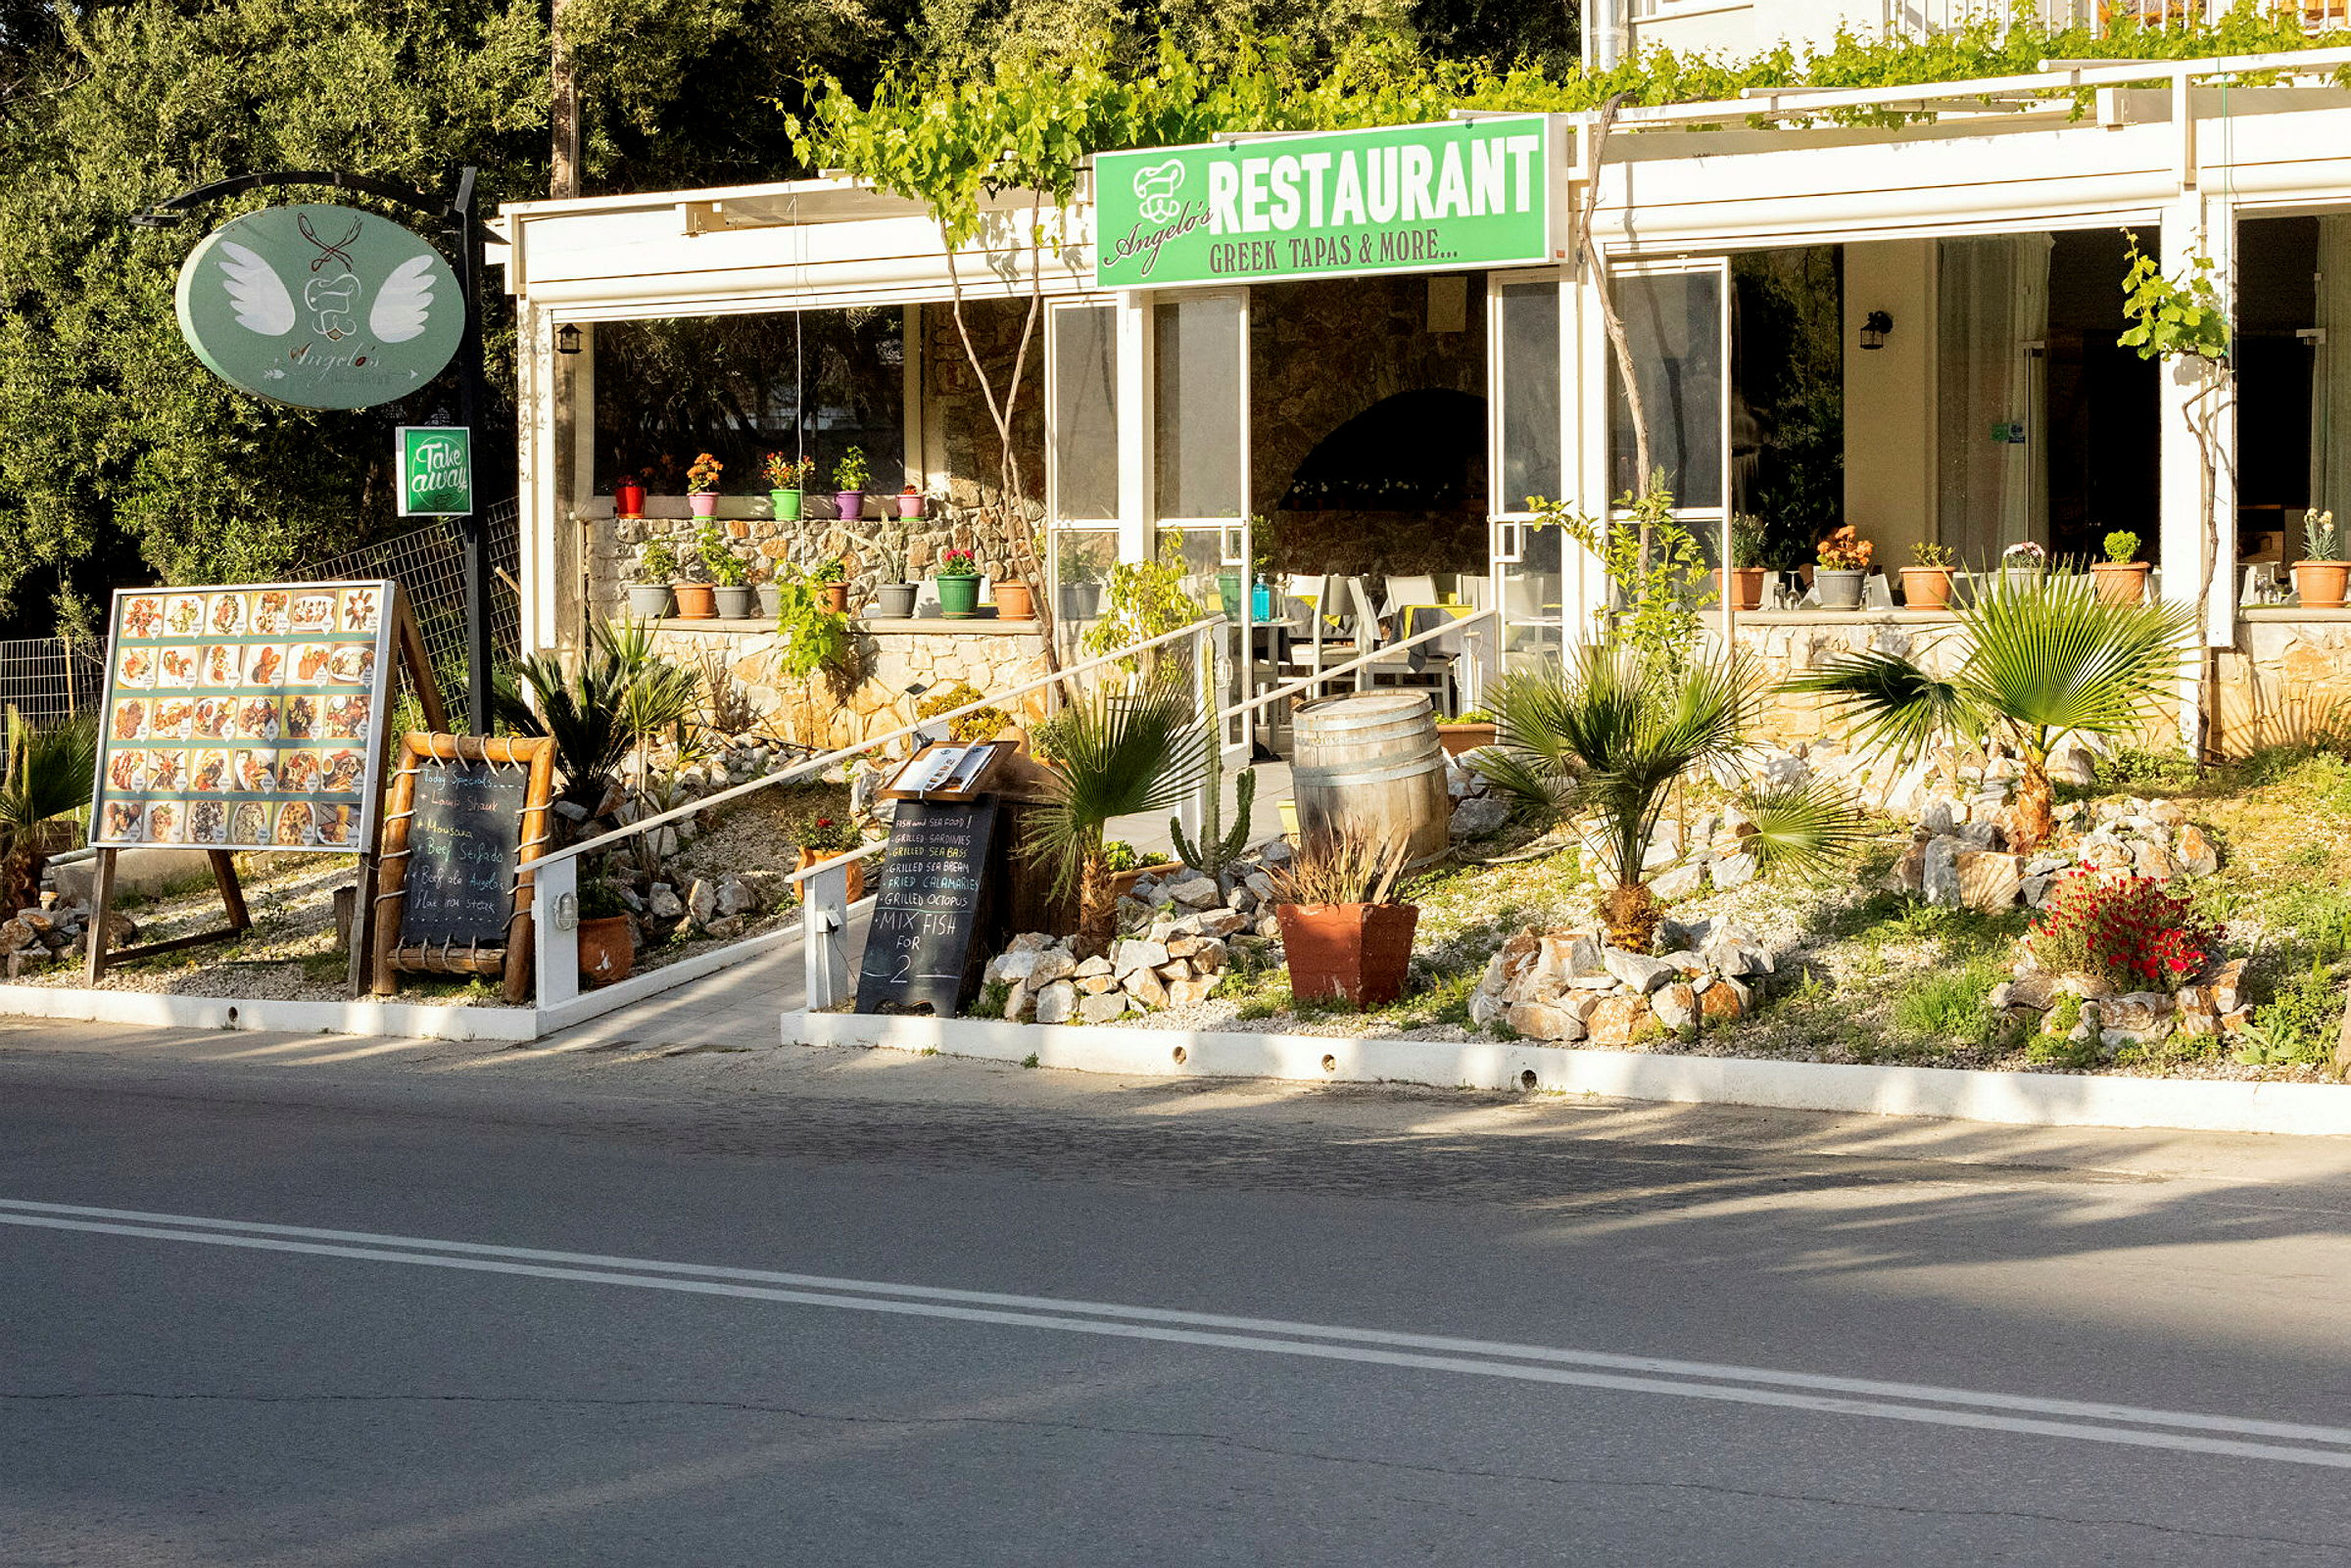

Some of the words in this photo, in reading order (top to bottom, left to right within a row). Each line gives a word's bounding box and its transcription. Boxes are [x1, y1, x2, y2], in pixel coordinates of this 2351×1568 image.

[1208, 134, 1540, 236] RESTAURANT
[1103, 200, 1214, 276] Angelo's
[1209, 239, 1278, 274] GREEK
[1288, 234, 1352, 268] TAPAS
[1359, 233, 1372, 263] &
[1379, 228, 1459, 262] MORE...
[289, 342, 380, 388] Angelo's
[415, 442, 463, 473] Take
[411, 466, 468, 494] away
[895, 819, 911, 829] FISH
[425, 836, 453, 863] Beef
[894, 832, 925, 843] GRILLED
[892, 846, 925, 858] GRILLED
[946, 847, 969, 858] BASS
[888, 862, 924, 874] GRILLED
[942, 860, 970, 875] BREAM
[888, 876, 916, 889] FRIED
[884, 892, 924, 906] GRILLED
[927, 893, 969, 907] OCTOPUS
[879, 911, 921, 930] MIX
[923, 913, 957, 935] FISH
[895, 934, 921, 951] FOR
[889, 954, 911, 983] 2
